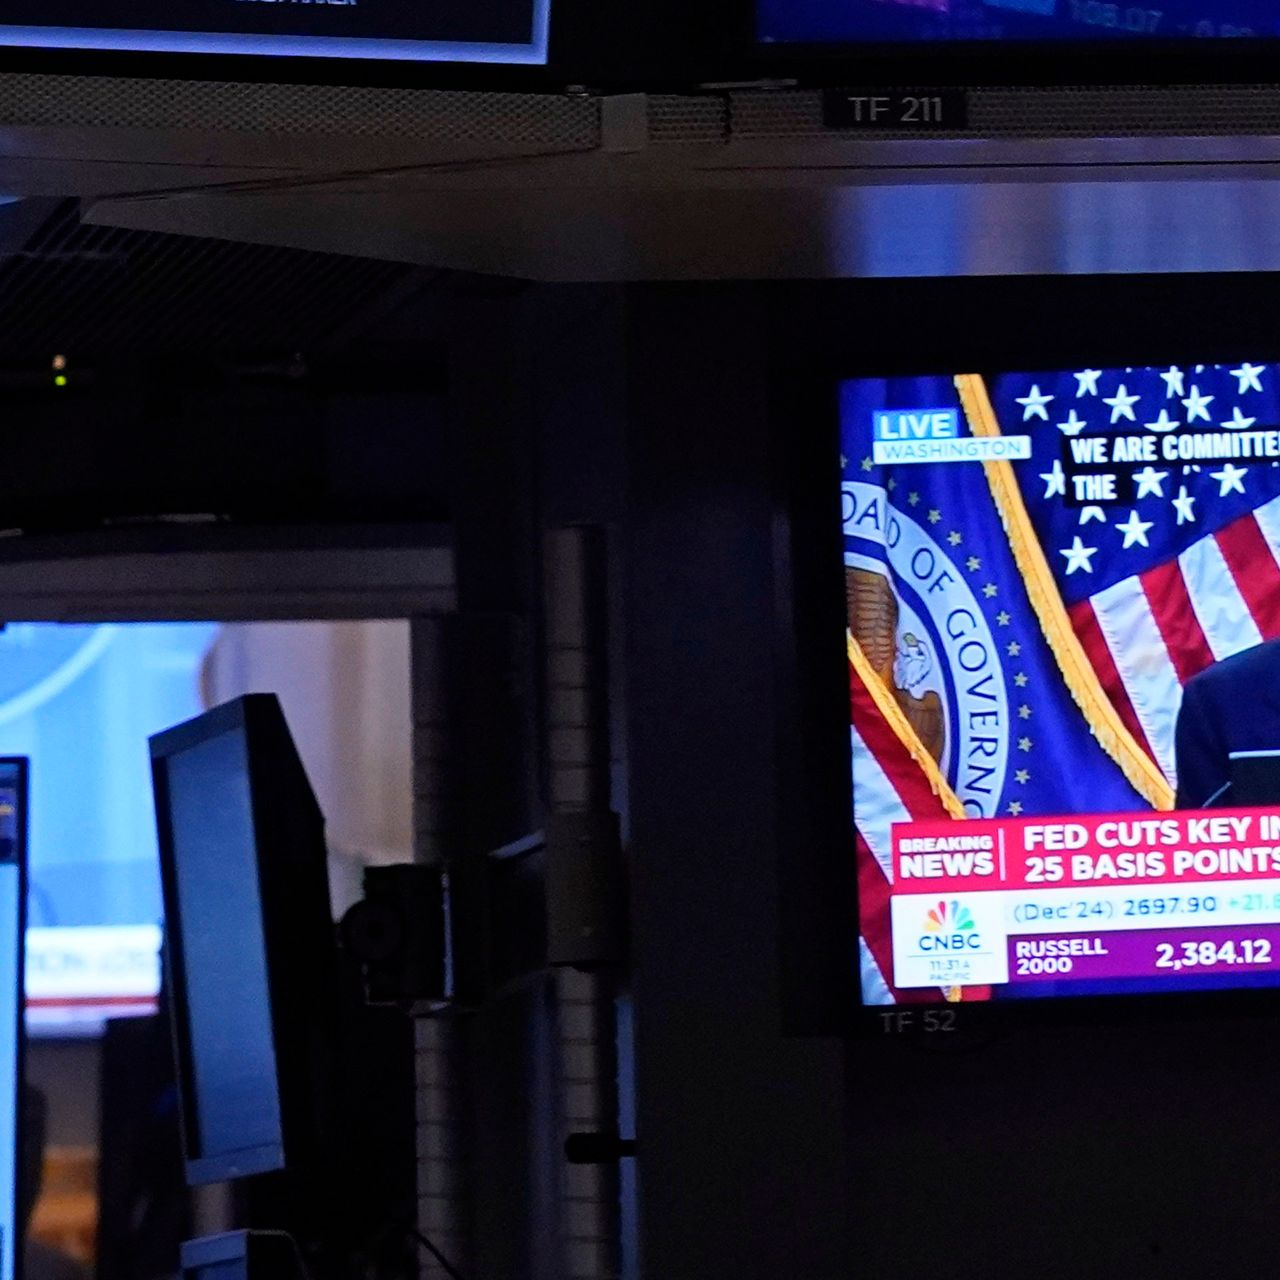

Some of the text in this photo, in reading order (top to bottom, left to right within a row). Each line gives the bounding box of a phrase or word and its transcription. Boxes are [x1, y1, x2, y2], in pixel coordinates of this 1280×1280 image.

[849, 98, 942, 121] TF 211
[880, 415, 951, 438] LIVE
[881, 439, 1022, 459] WASHINGTON
[1071, 438, 1107, 463] WE
[1112, 438, 1156, 462] ARE
[1074, 477, 1117, 500] THE
[901, 836, 992, 852] BREAKING
[1024, 825, 1087, 851] FED
[1095, 821, 1179, 846] CUTS
[1188, 817, 1252, 844] KEY
[901, 852, 993, 877] NEWS
[1025, 856, 1063, 882] 25
[1072, 853, 1166, 881] BASIS
[919, 934, 981, 951] CNBC
[1016, 939, 1107, 958] RUSSELL
[1155, 940, 1271, 970] 2,384.12
[1016, 957, 1072, 976] 2000
[880, 1011, 956, 1031] TF 52
